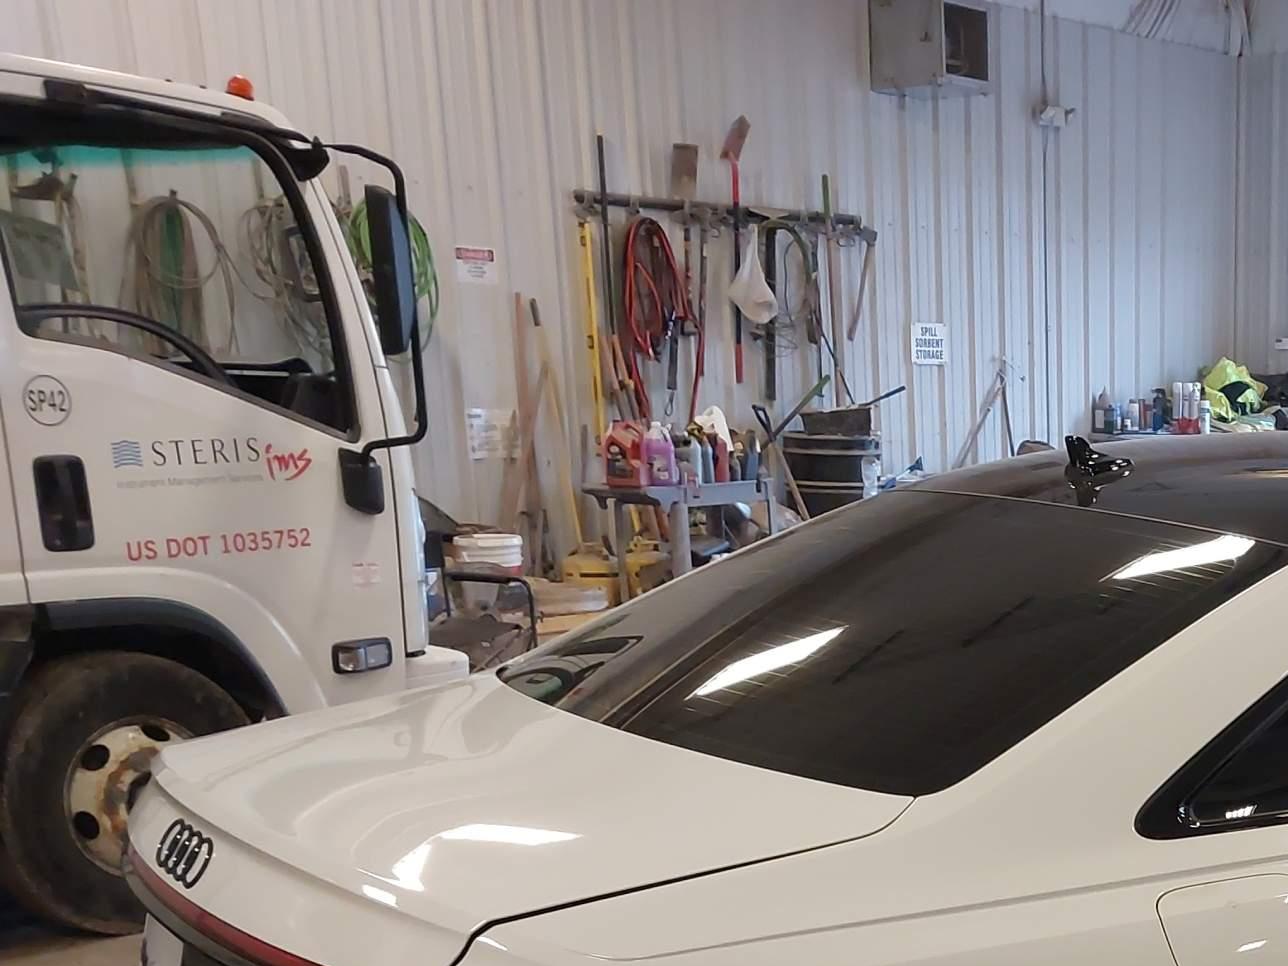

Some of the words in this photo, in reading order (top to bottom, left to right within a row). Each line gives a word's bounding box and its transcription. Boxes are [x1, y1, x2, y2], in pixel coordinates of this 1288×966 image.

[920, 326, 938, 337] SPILL
[915, 338, 944, 349] SORBENT
[915, 349, 944, 360] STORAGE
[28, 389, 67, 412] SP42
[151, 437, 261, 466] STERIS
[264, 443, 313, 481] ims
[126, 540, 158, 561] US
[165, 535, 211, 558] DOT
[219, 527, 312, 554] 1035752
